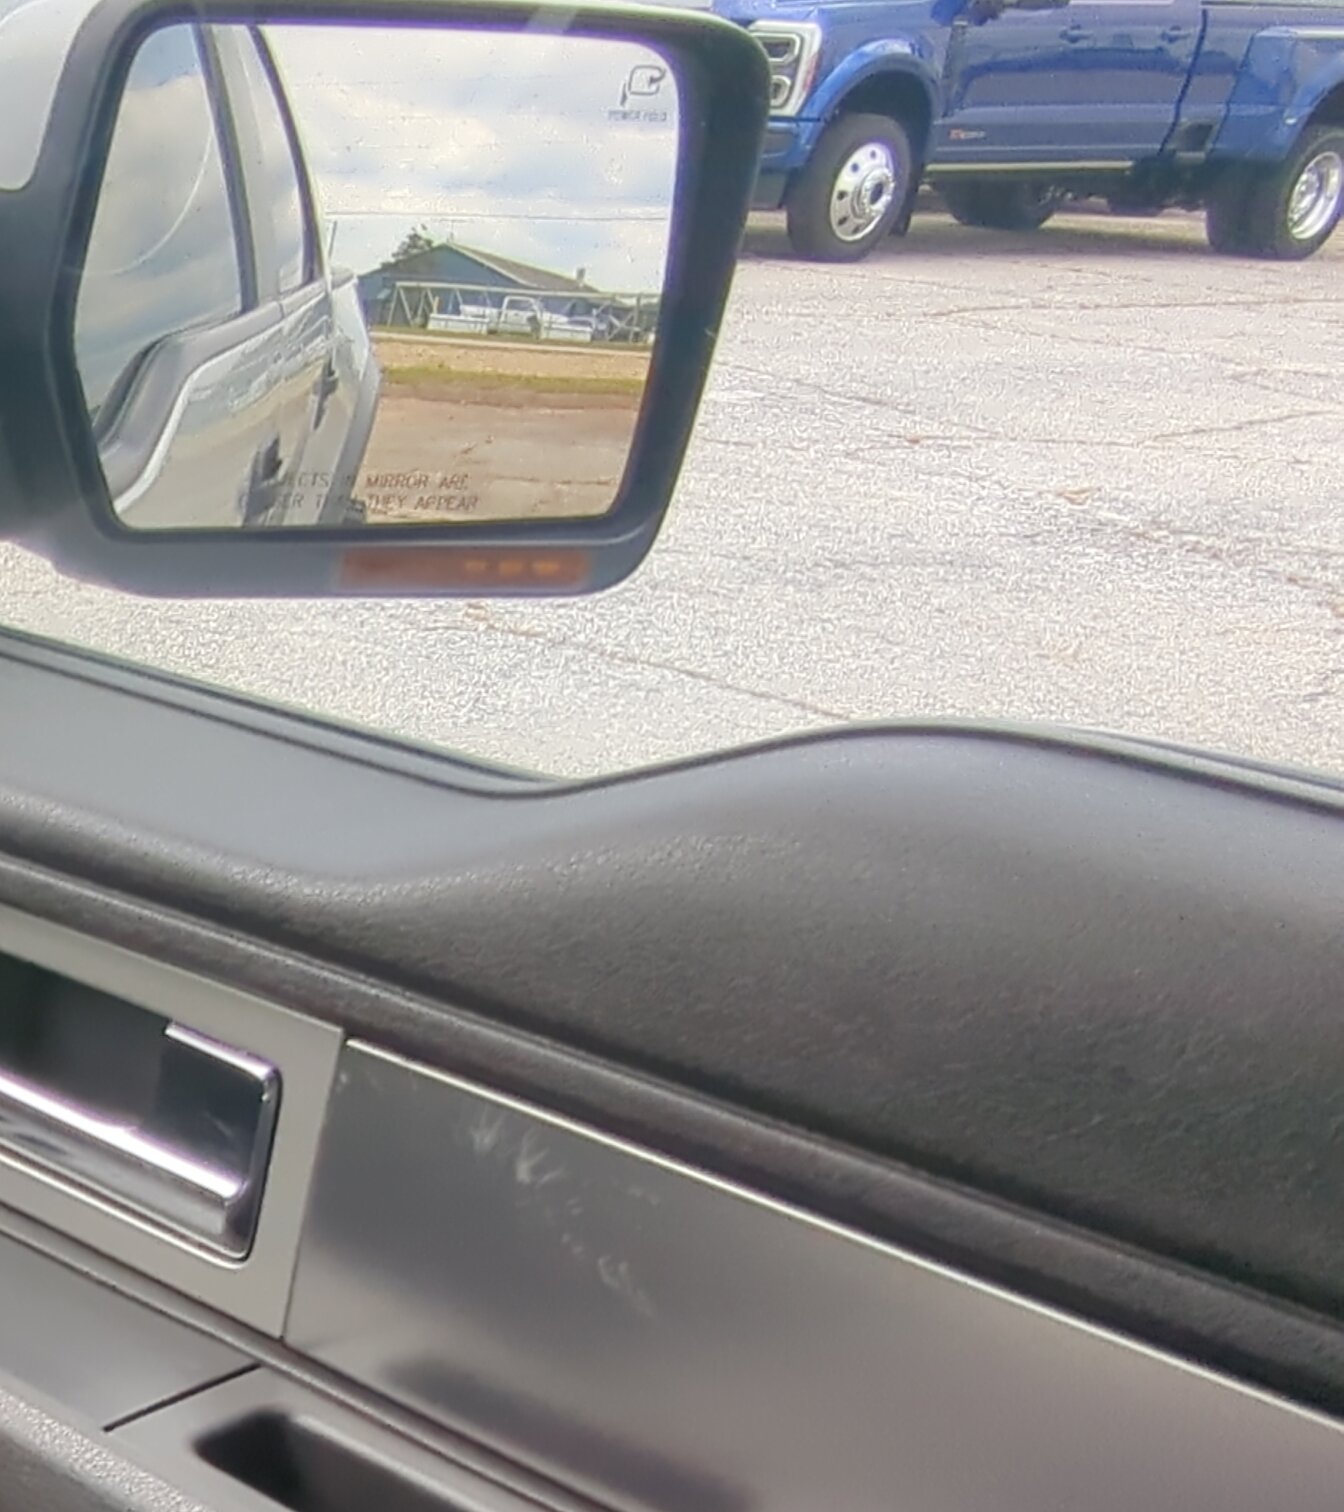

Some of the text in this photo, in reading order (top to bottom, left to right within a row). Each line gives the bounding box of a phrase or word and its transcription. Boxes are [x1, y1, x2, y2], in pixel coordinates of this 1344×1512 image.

[365, 473, 428, 488] MIRROR
[366, 493, 408, 510] THEY
[414, 495, 479, 511] APPEAR
